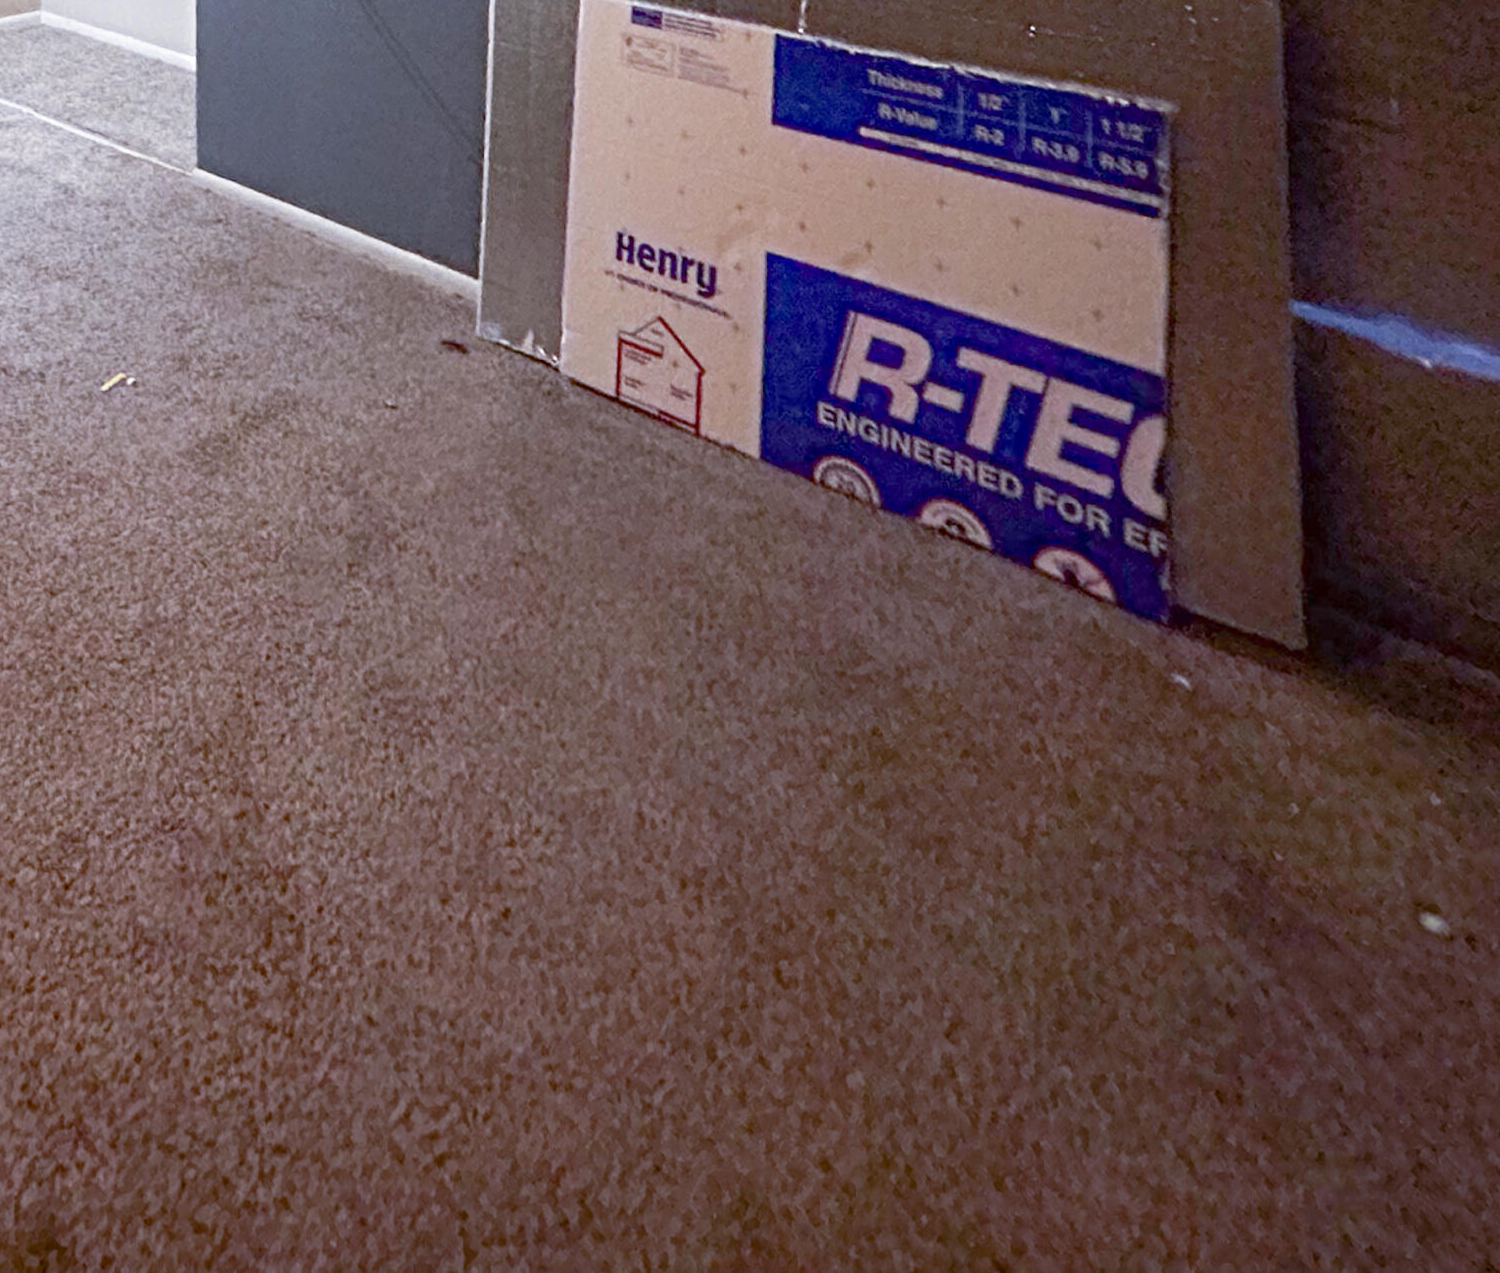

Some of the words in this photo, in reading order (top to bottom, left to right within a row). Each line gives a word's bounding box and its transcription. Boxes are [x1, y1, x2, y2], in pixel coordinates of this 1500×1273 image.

[866, 68, 944, 100] Thickness
[878, 101, 938, 132] R-Value
[974, 123, 1005, 147] R-2
[616, 231, 717, 299] Henry
[816, 400, 1024, 501] ENGINEERED
[1033, 481, 1112, 538] FOR
